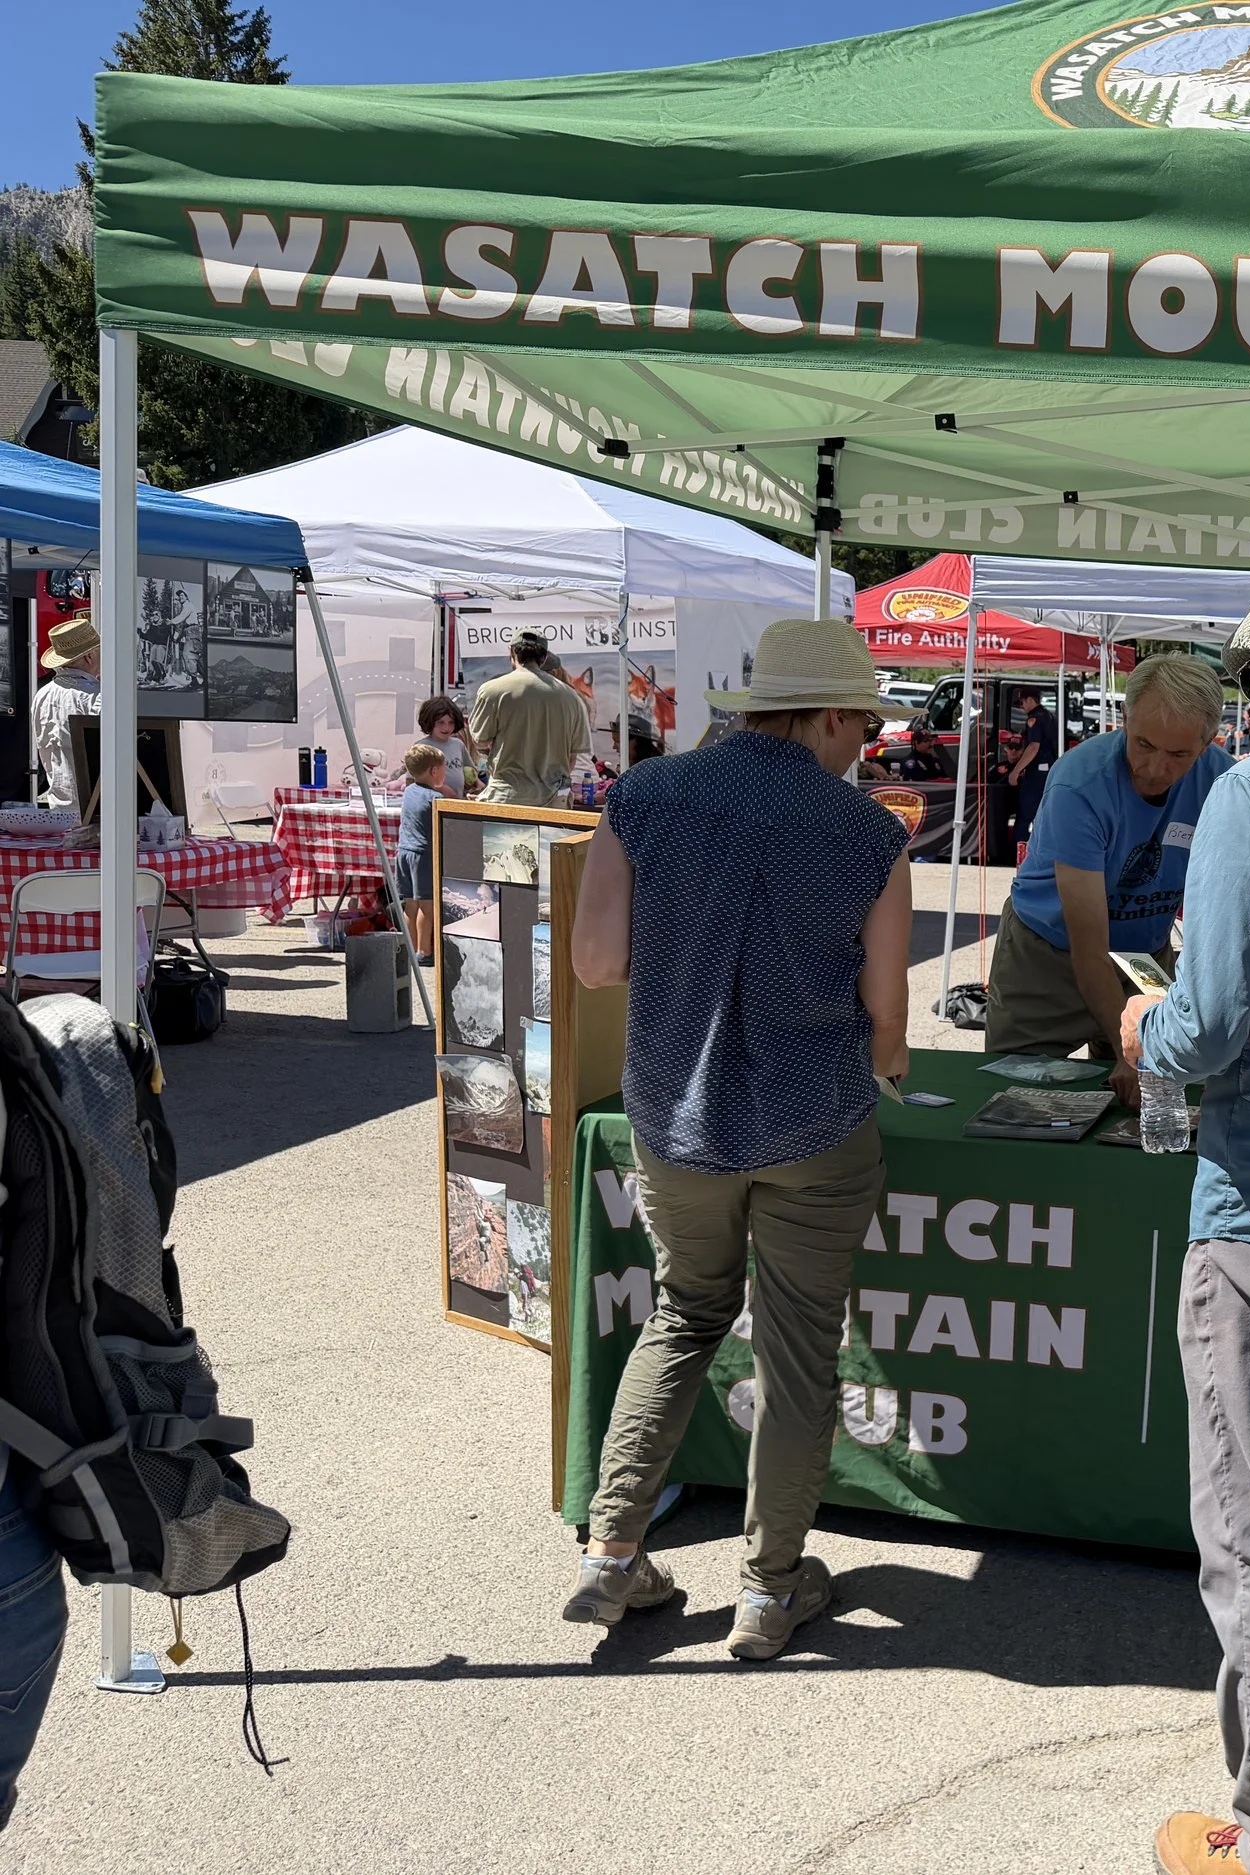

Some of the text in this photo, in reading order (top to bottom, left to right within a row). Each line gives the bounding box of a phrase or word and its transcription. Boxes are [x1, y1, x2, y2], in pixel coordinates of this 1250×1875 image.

[1048, 10, 1203, 101] WASATCH
[188, 210, 921, 340] WASATCH
[467, 623, 573, 645] BRIGON
[875, 628, 912, 646] Fire
[918, 631, 1011, 653] Authrity
